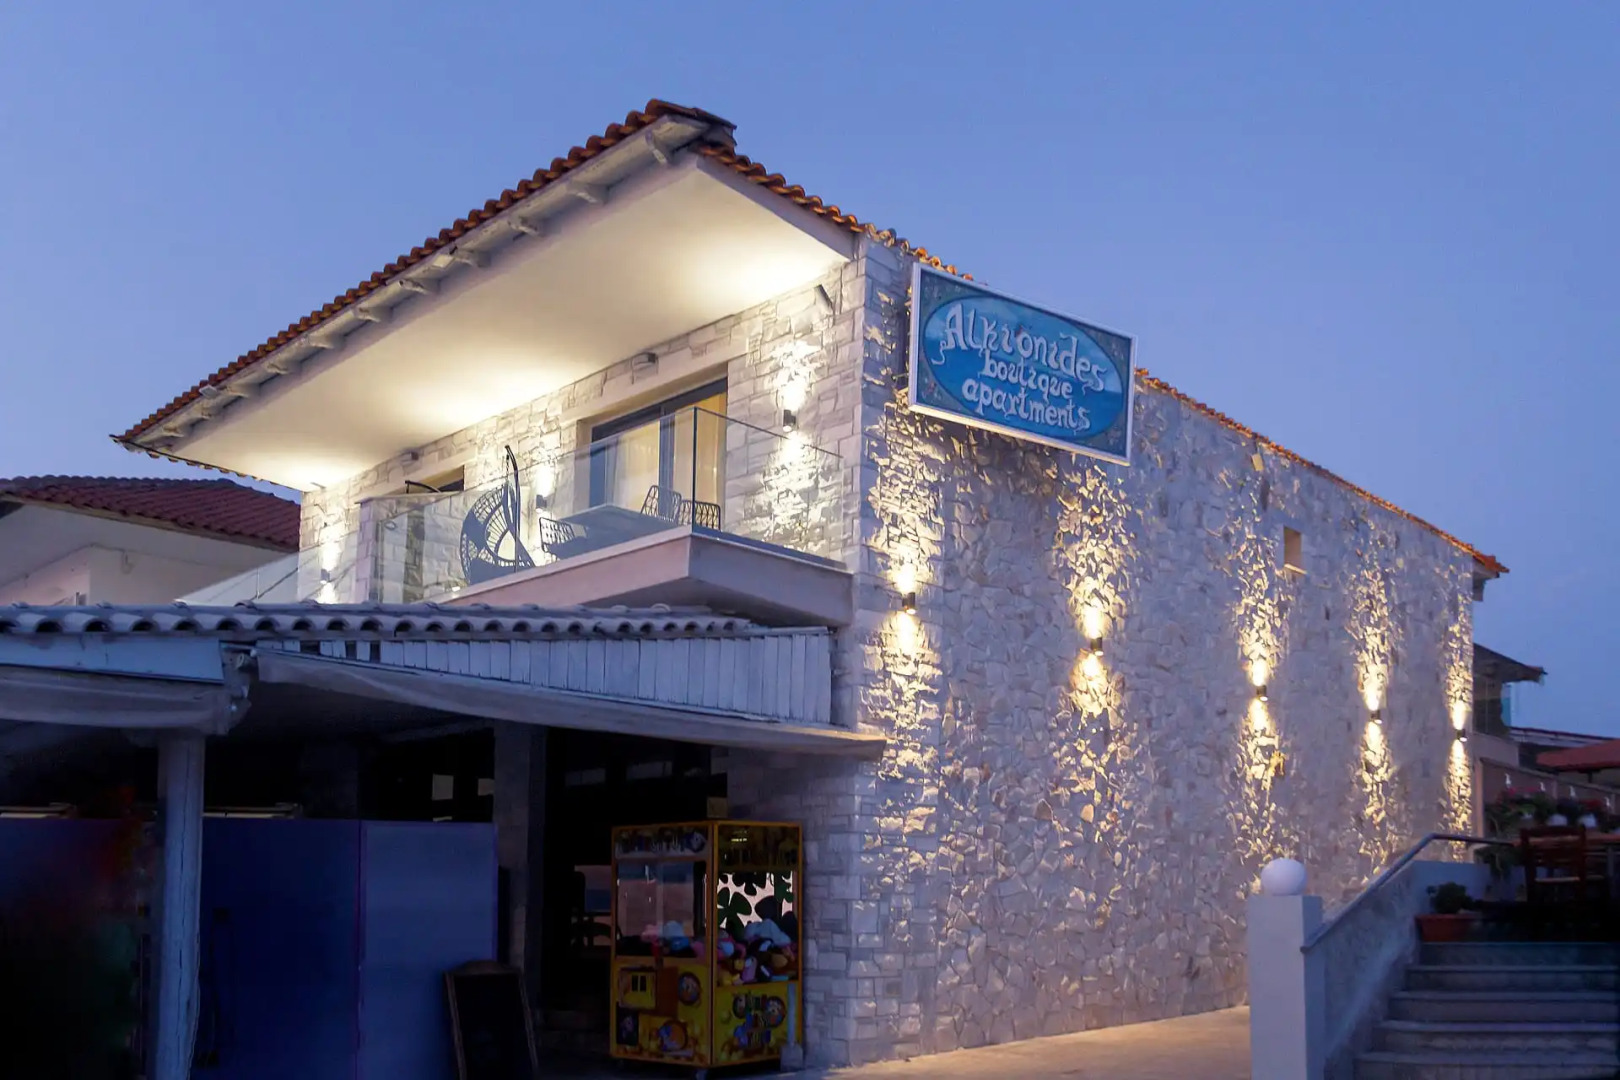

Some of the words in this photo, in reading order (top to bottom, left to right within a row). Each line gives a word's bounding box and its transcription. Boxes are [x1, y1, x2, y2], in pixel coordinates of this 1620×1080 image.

[931, 303, 1107, 394] Alkionides
[979, 349, 1073, 403] boutique
[962, 378, 1091, 435] apartments
